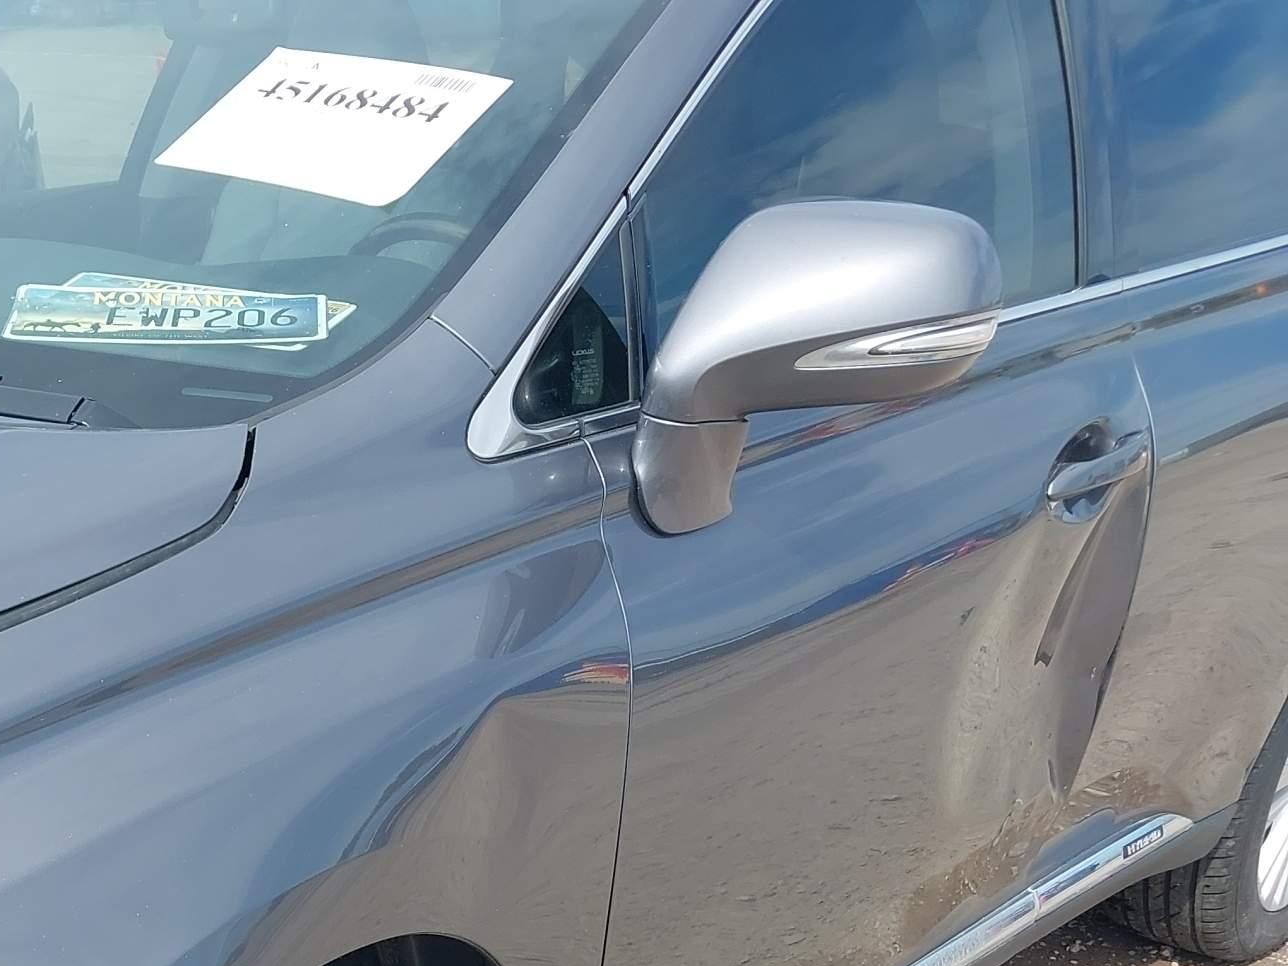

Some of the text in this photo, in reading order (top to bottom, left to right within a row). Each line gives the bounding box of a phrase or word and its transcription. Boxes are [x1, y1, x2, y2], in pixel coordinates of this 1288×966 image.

[257, 78, 449, 122] 45168484
[93, 291, 245, 307] MONTANA
[106, 307, 298, 328] EWP206
